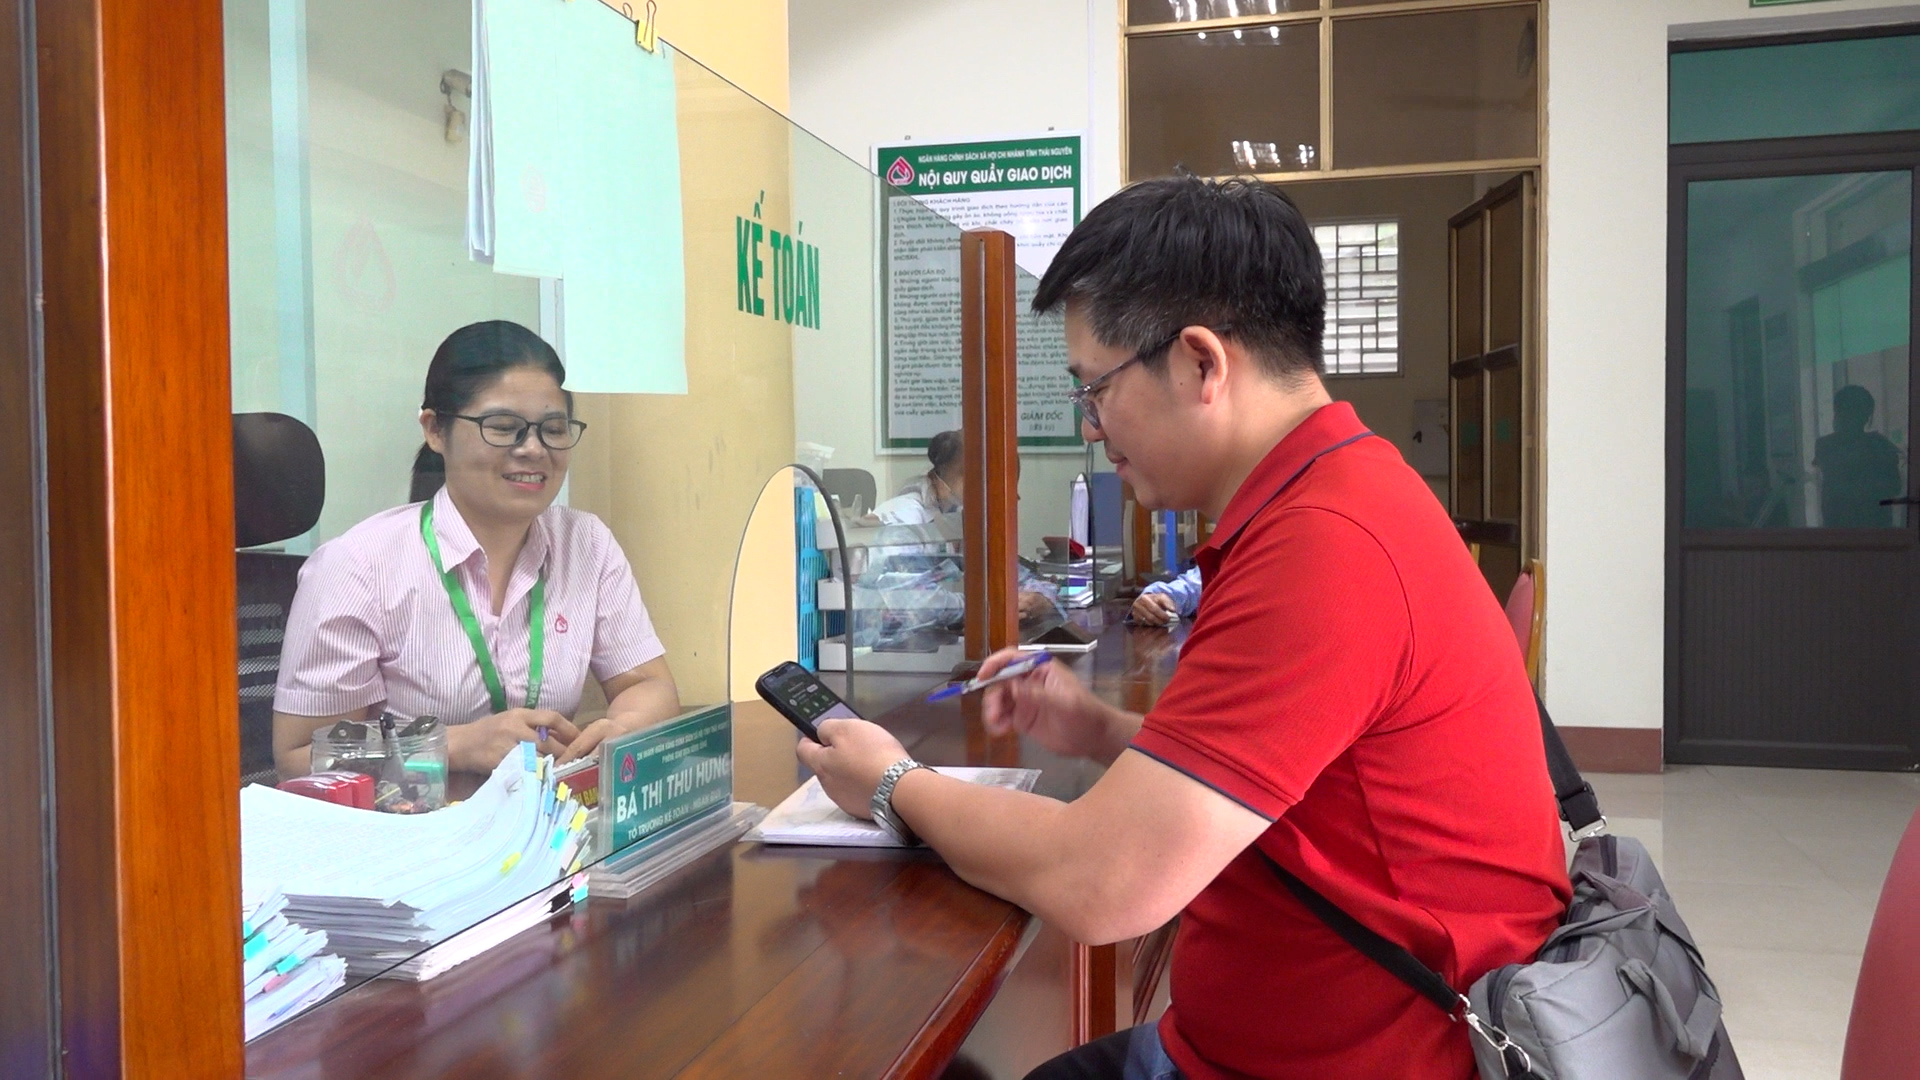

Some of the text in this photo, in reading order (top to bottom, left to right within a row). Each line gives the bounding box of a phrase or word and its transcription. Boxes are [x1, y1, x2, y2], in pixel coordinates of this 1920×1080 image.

[918, 169, 940, 190] NỘI
[943, 170, 968, 186] QUY
[1007, 167, 1038, 182] GIAO
[1042, 165, 1072, 184] DỊCH
[736, 190, 820, 330] KẾ TOÁN
[616, 786, 638, 824] BÁ
[641, 780, 662, 811] THỊ
[666, 767, 692, 800] THU
